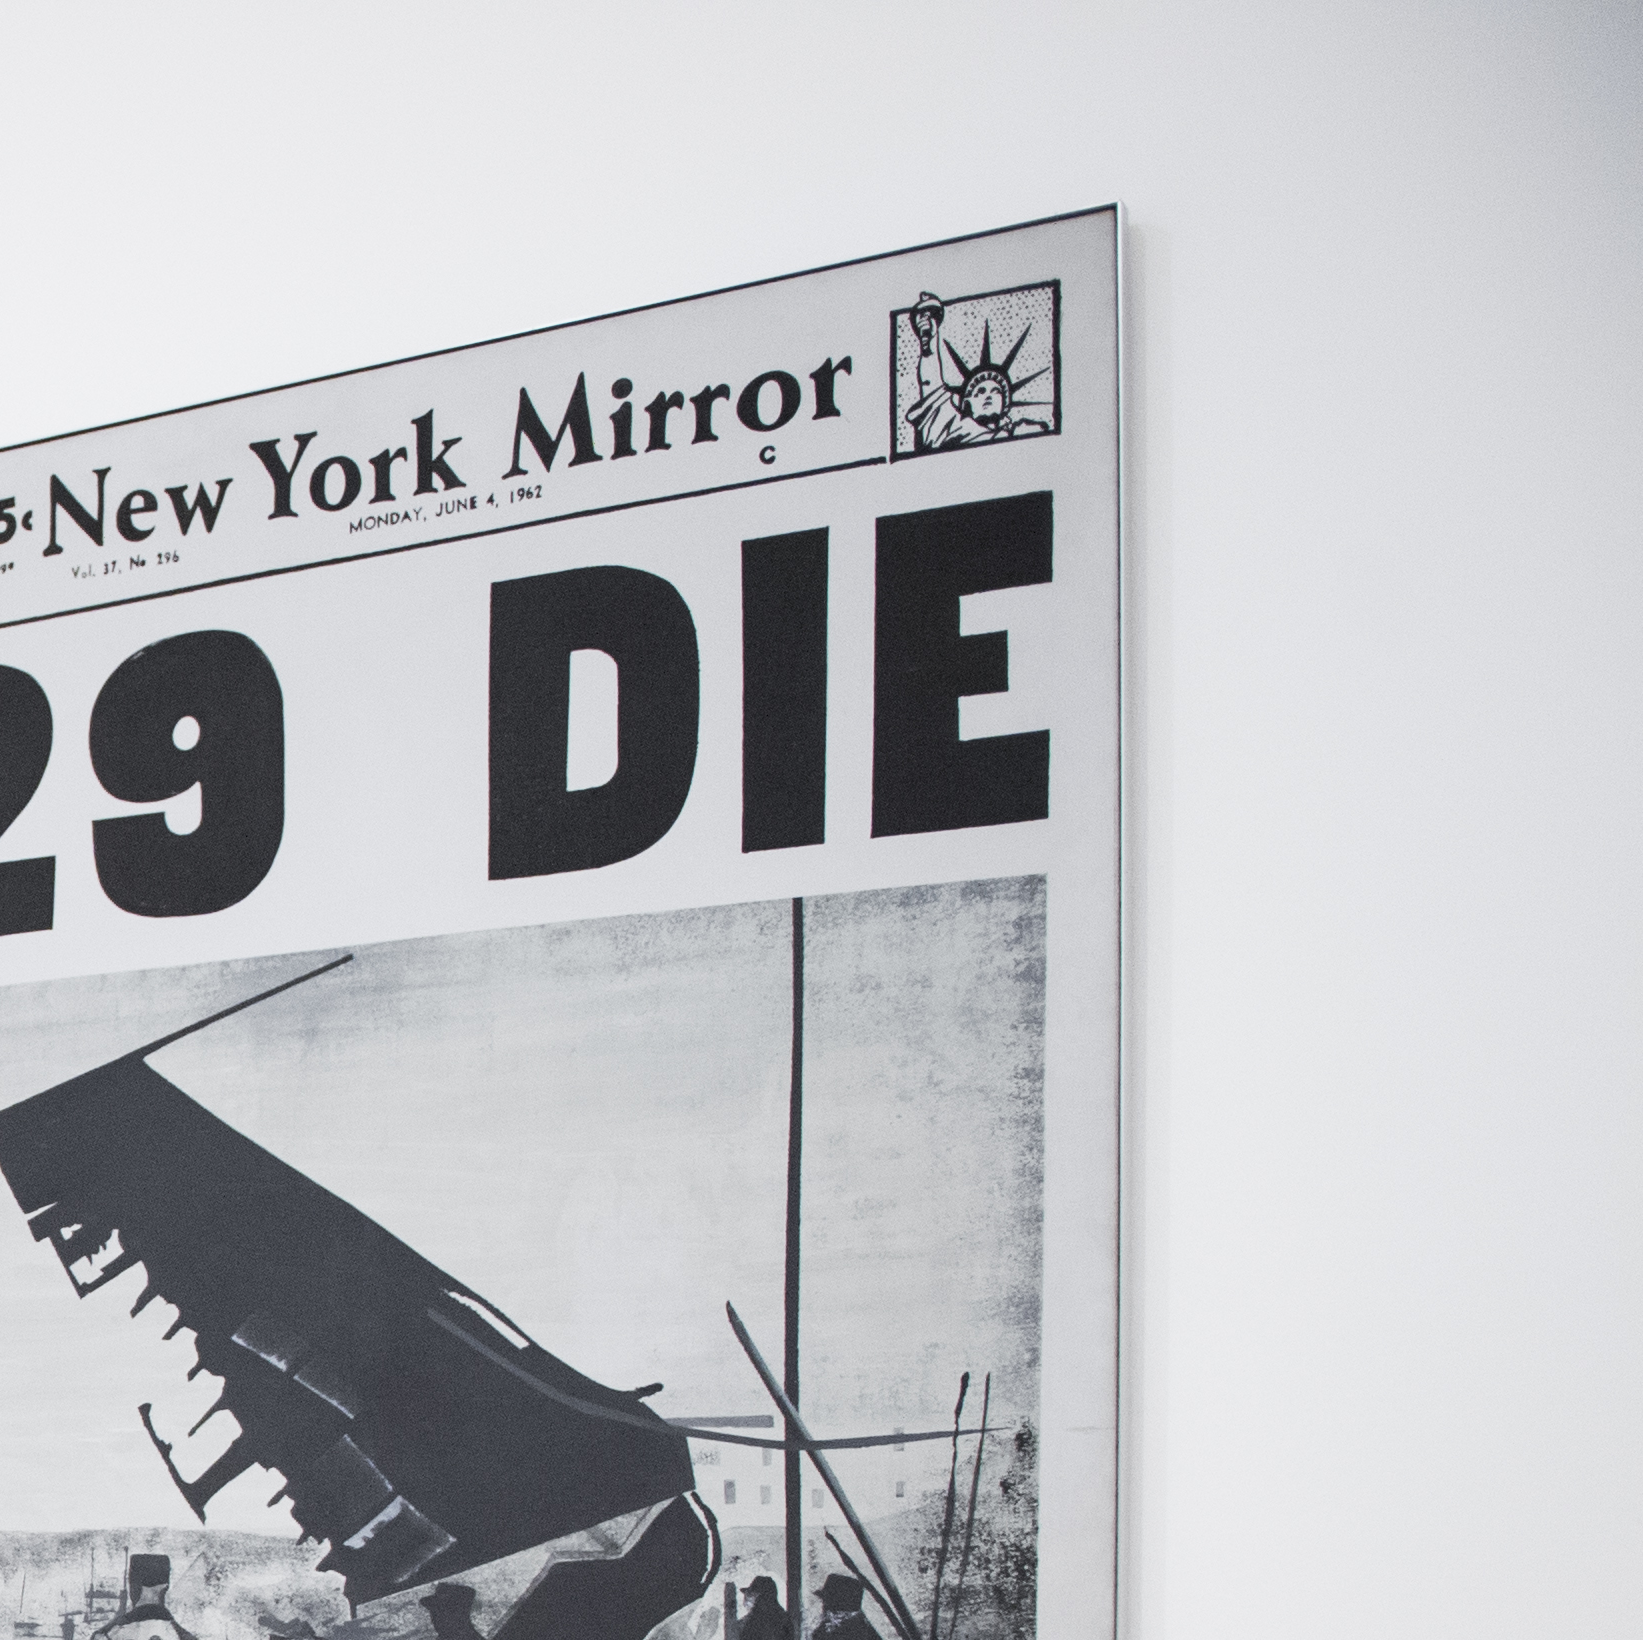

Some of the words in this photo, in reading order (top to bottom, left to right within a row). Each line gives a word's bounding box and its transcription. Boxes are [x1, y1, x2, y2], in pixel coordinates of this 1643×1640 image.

[42, 466, 234, 558] New
[248, 408, 467, 521] York
[501, 355, 853, 480] Mirror
[349, 507, 427, 534] MONDAY,
[435, 495, 478, 517] JUNE
[485, 493, 499, 508] 4,
[510, 485, 543, 504] 1962
[71, 564, 96, 578] Vol.
[488, 490, 1054, 881] DIE
